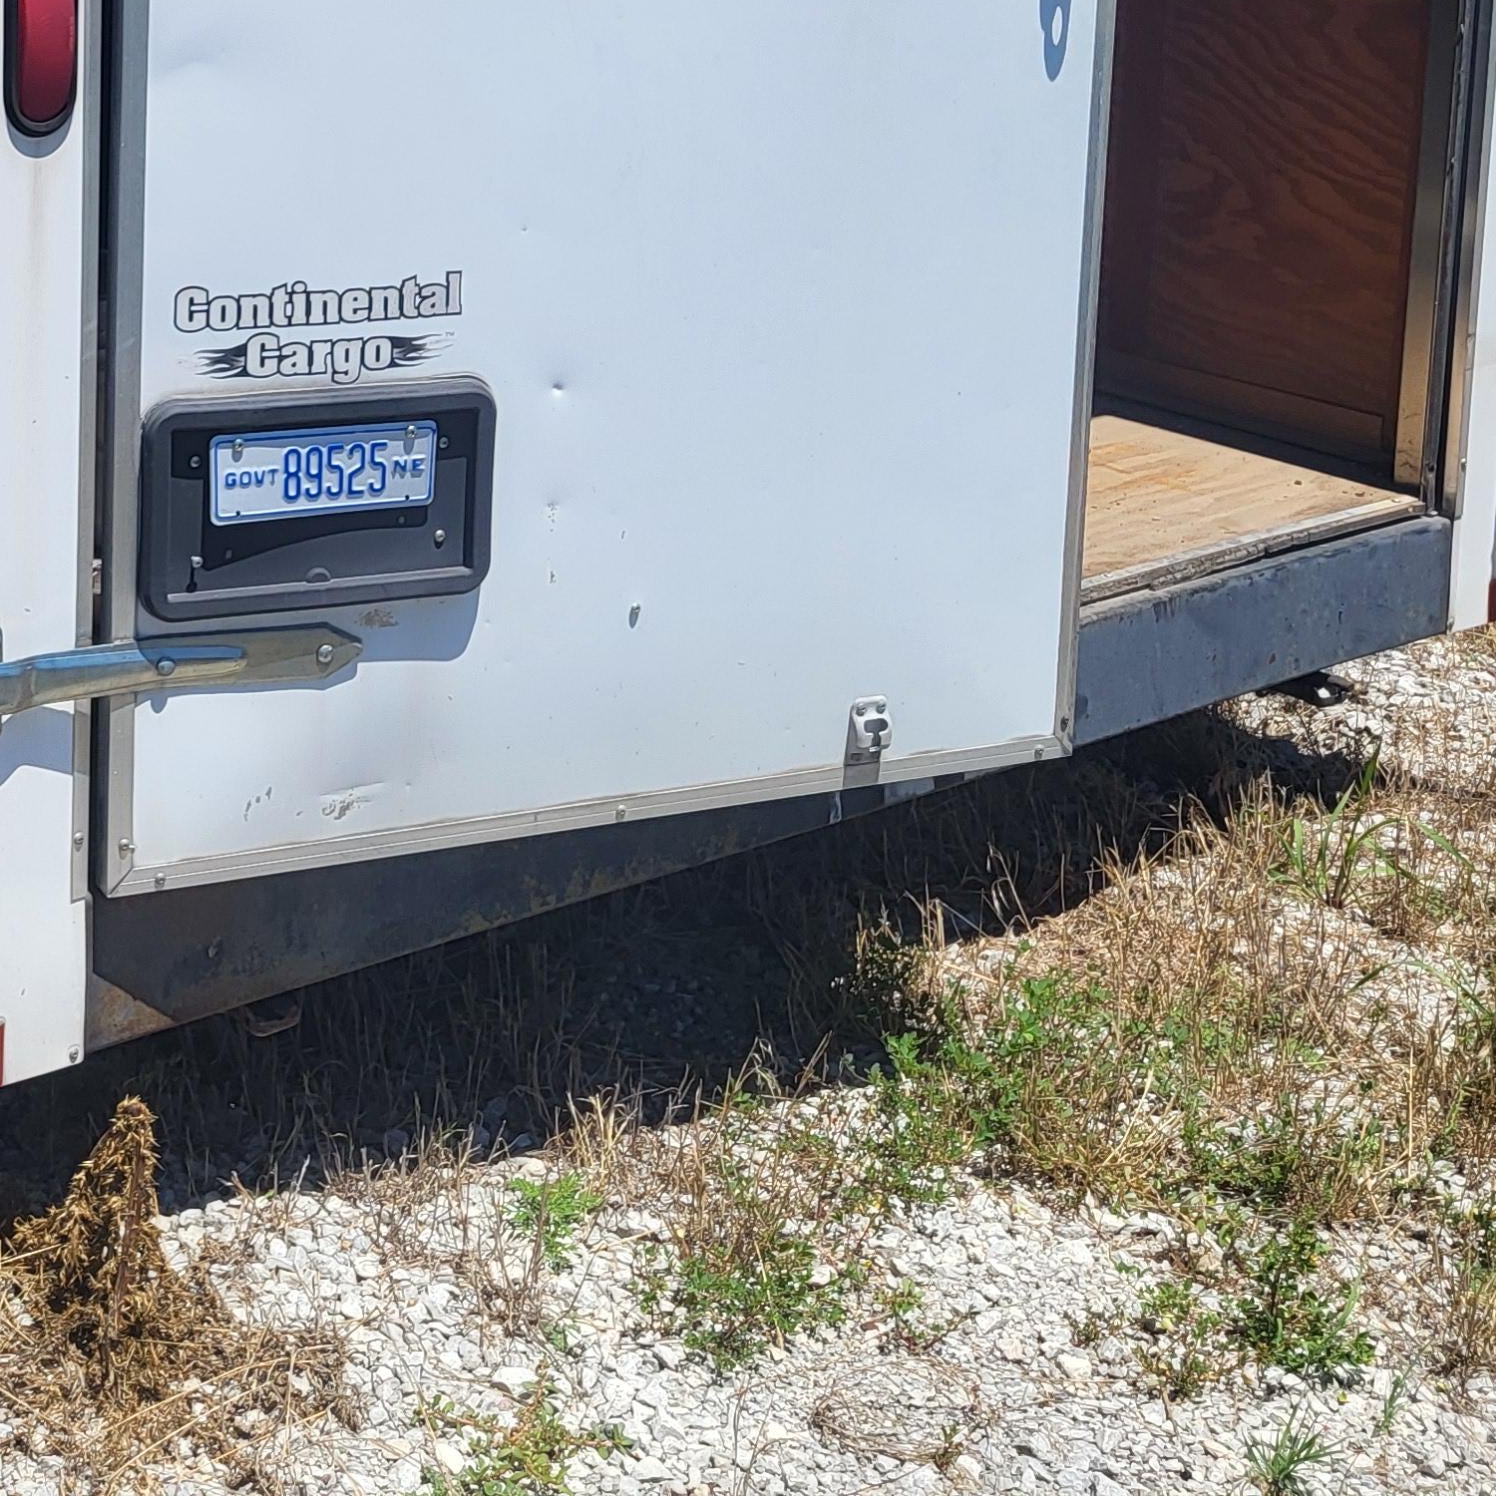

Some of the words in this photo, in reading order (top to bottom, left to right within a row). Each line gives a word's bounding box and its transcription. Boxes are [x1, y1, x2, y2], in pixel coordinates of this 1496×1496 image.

[174, 270, 463, 333] Continental
[245, 332, 394, 385] Cargo
[224, 467, 280, 489] GOVT
[283, 440, 389, 502] 89525
[392, 456, 427, 475] NE
